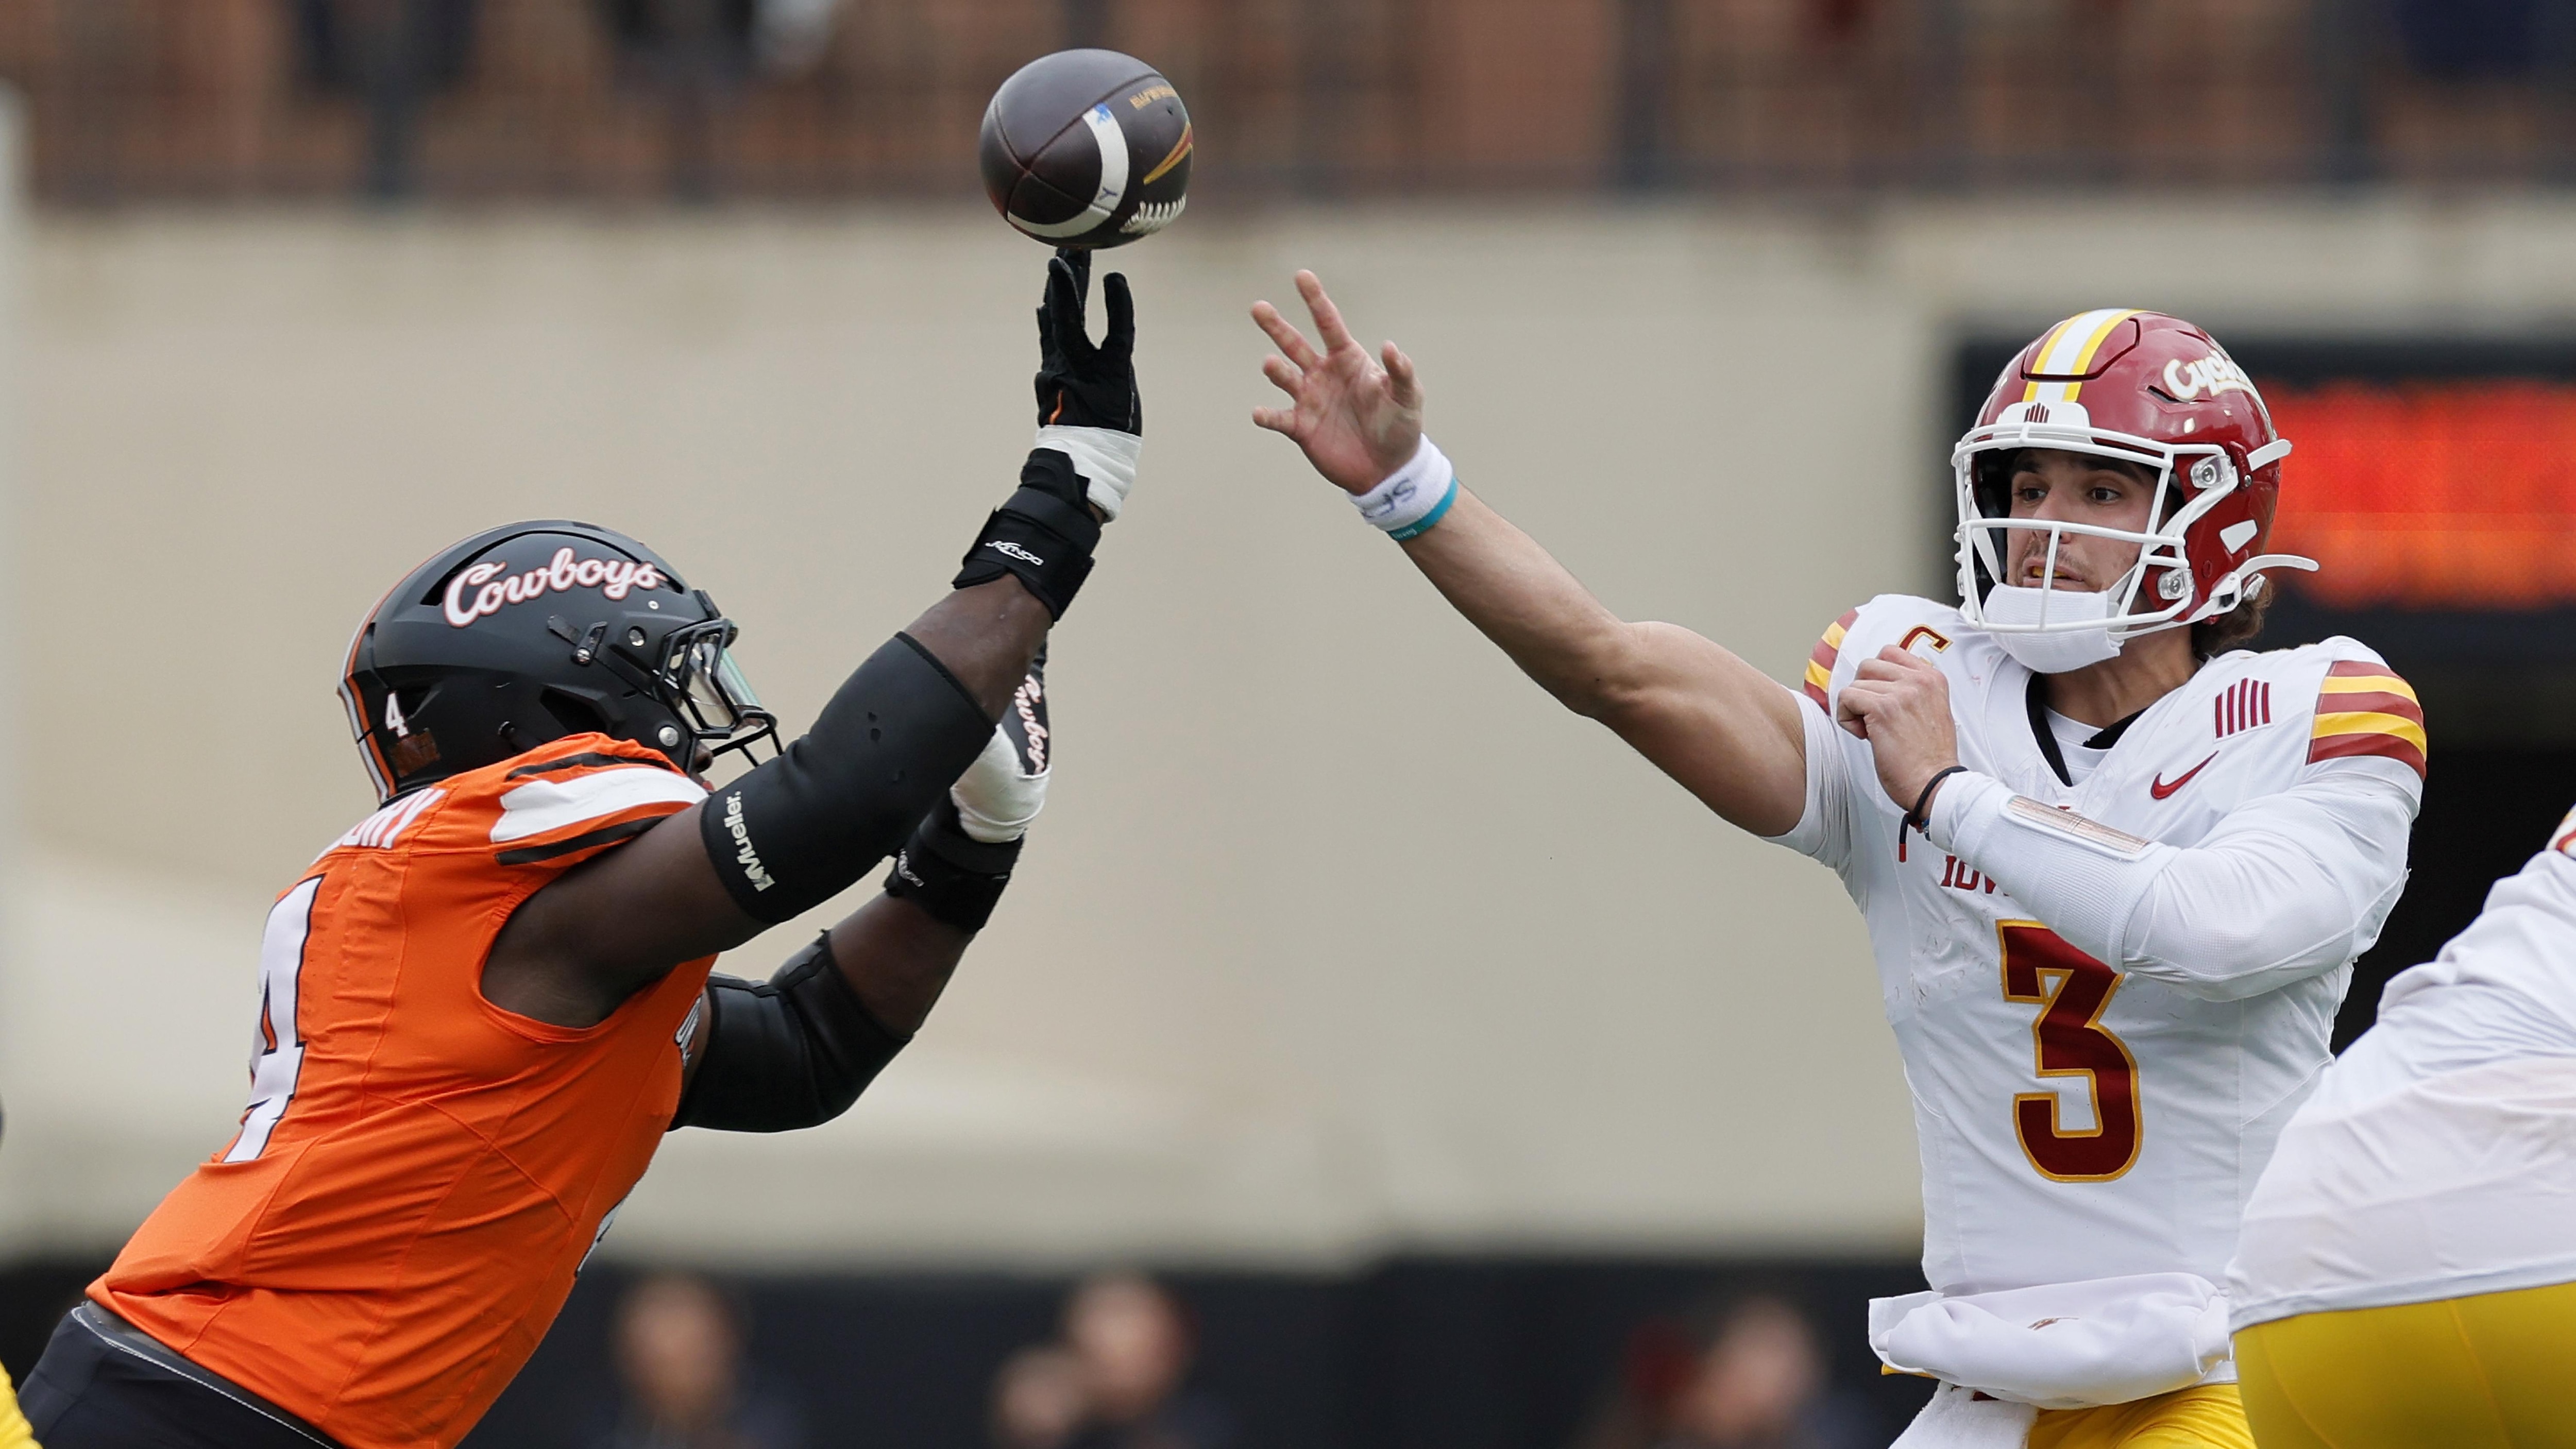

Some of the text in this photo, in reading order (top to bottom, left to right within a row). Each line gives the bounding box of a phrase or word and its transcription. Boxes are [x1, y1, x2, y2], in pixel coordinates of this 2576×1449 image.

[443, 547, 668, 627] Cowboys
[385, 693, 409, 738] 4
[222, 873, 326, 1164] 4
[1995, 919, 2143, 1183] 3
